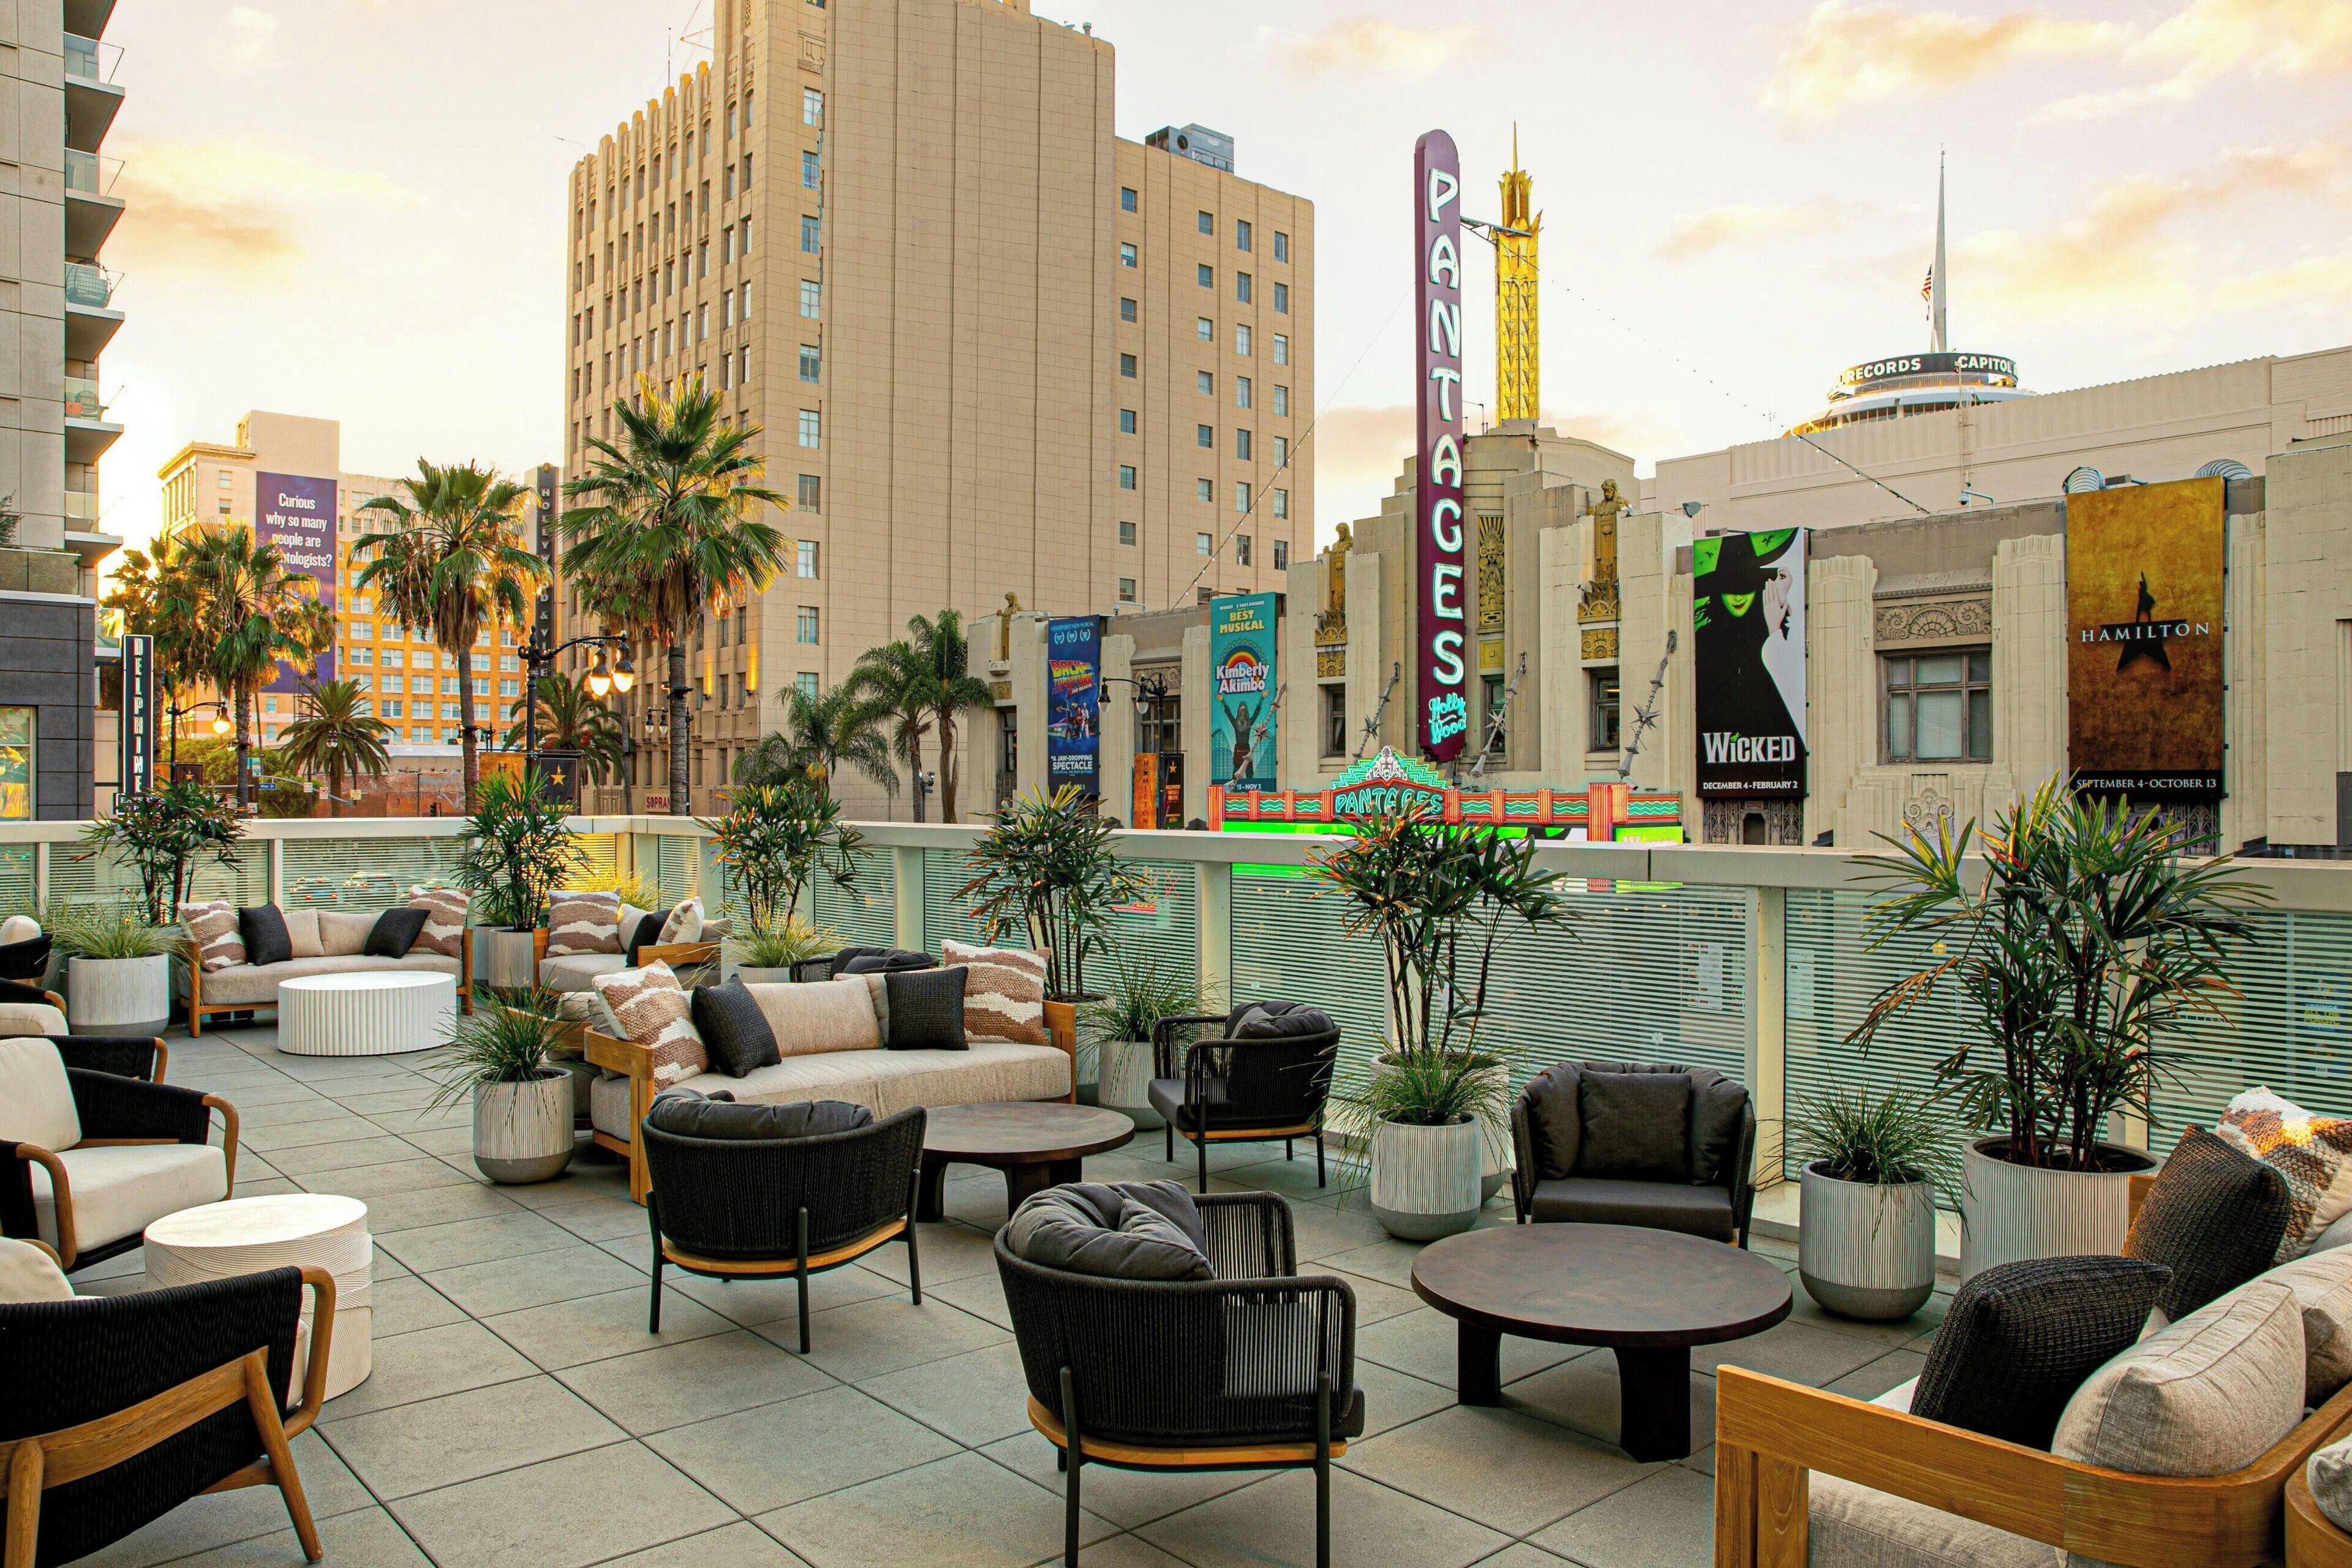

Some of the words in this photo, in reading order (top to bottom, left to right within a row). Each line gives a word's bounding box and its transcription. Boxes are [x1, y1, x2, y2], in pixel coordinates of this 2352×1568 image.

[1847, 358, 1921, 383] RECORDS
[1957, 356, 2013, 374] CAPITOL
[1428, 167, 1465, 685] PANTAGES
[279, 492, 315, 510] Curious
[266, 511, 286, 528] why
[288, 516, 300, 527] so
[301, 517, 327, 532] many
[272, 532, 303, 548] people
[305, 537, 322, 548] are
[1229, 610, 1254, 622] BEST
[1219, 620, 1264, 634] MUSICAL
[2082, 622, 2209, 642] HAMILTON
[1049, 659, 1084, 678] BACK
[1216, 661, 1269, 680] Kimberly
[1219, 677, 1265, 693] Akimbo
[133, 638, 143, 793] DELPHINE
[1053, 761, 1092, 770] SPECTACLE
[2076, 779, 2135, 788] SEPTEMBER
[2206, 779, 2216, 788] 13
[1335, 788, 1443, 814] PANTAGES
